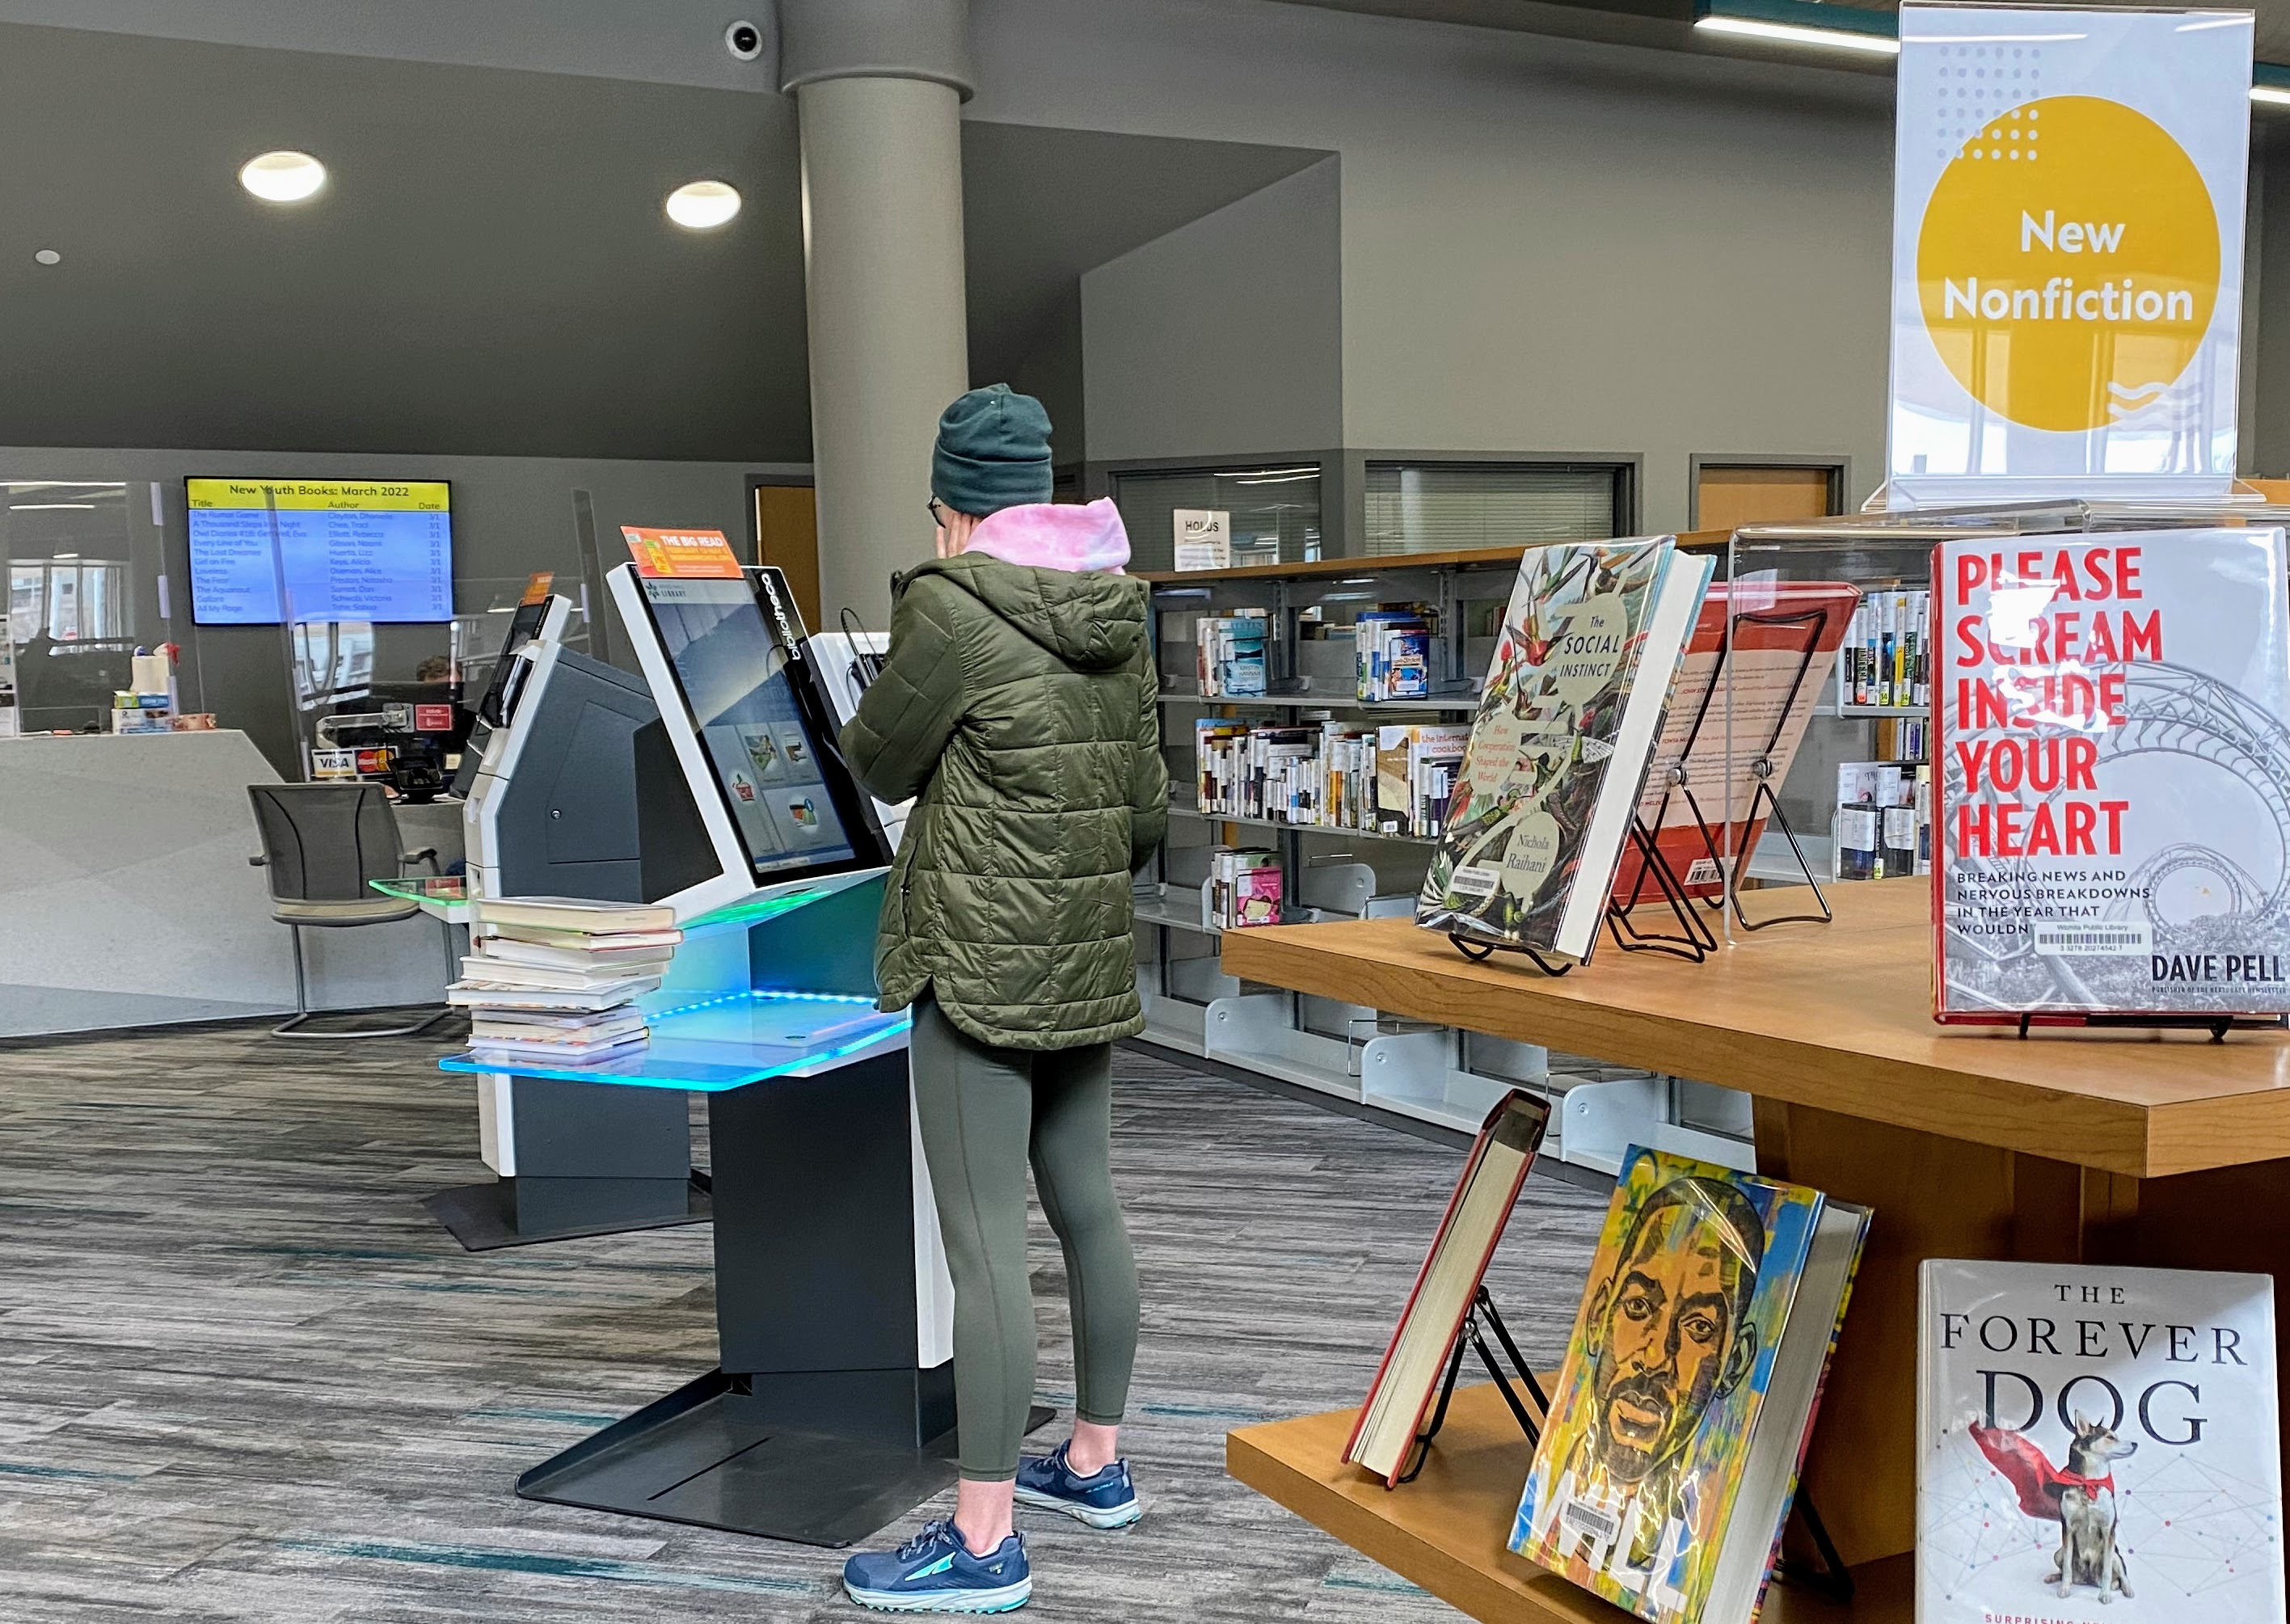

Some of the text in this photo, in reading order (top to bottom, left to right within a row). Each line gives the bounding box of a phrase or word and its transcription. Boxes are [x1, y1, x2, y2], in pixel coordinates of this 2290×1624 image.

[2021, 209, 2126, 253] New
[1944, 276, 2193, 321] Nonfiction
[230, 485, 409, 496] New Youth Books: March 2022
[192, 499, 440, 510] Title Author Date
[1185, 521, 1219, 532] HOLDS
[660, 535, 724, 547] THE BIG READ
[1958, 546, 2143, 605] PLEASE
[1590, 615, 1605, 628] The
[1564, 635, 1620, 655] SOCIAL
[1559, 664, 1611, 677] INSTINCT
[1421, 734, 1435, 744] the
[319, 757, 349, 768] VISA
[1955, 736, 2098, 793] YOUR
[1959, 800, 2130, 858] HEART
[1516, 834, 1550, 850] Nichola
[1506, 853, 1547, 872] Raihani
[1957, 870, 2126, 884] BREAKING NEWS AND
[1957, 888, 2150, 901] NERVOUS BREAKDOWNS
[1958, 905, 2100, 917] IN THE YEAR THAT
[2152, 955, 2286, 981] DAVE PELL
[2054, 1284, 2126, 1305] THE
[1940, 1313, 2248, 1366] FOREVER
[1976, 1369, 2208, 1445] DOG
